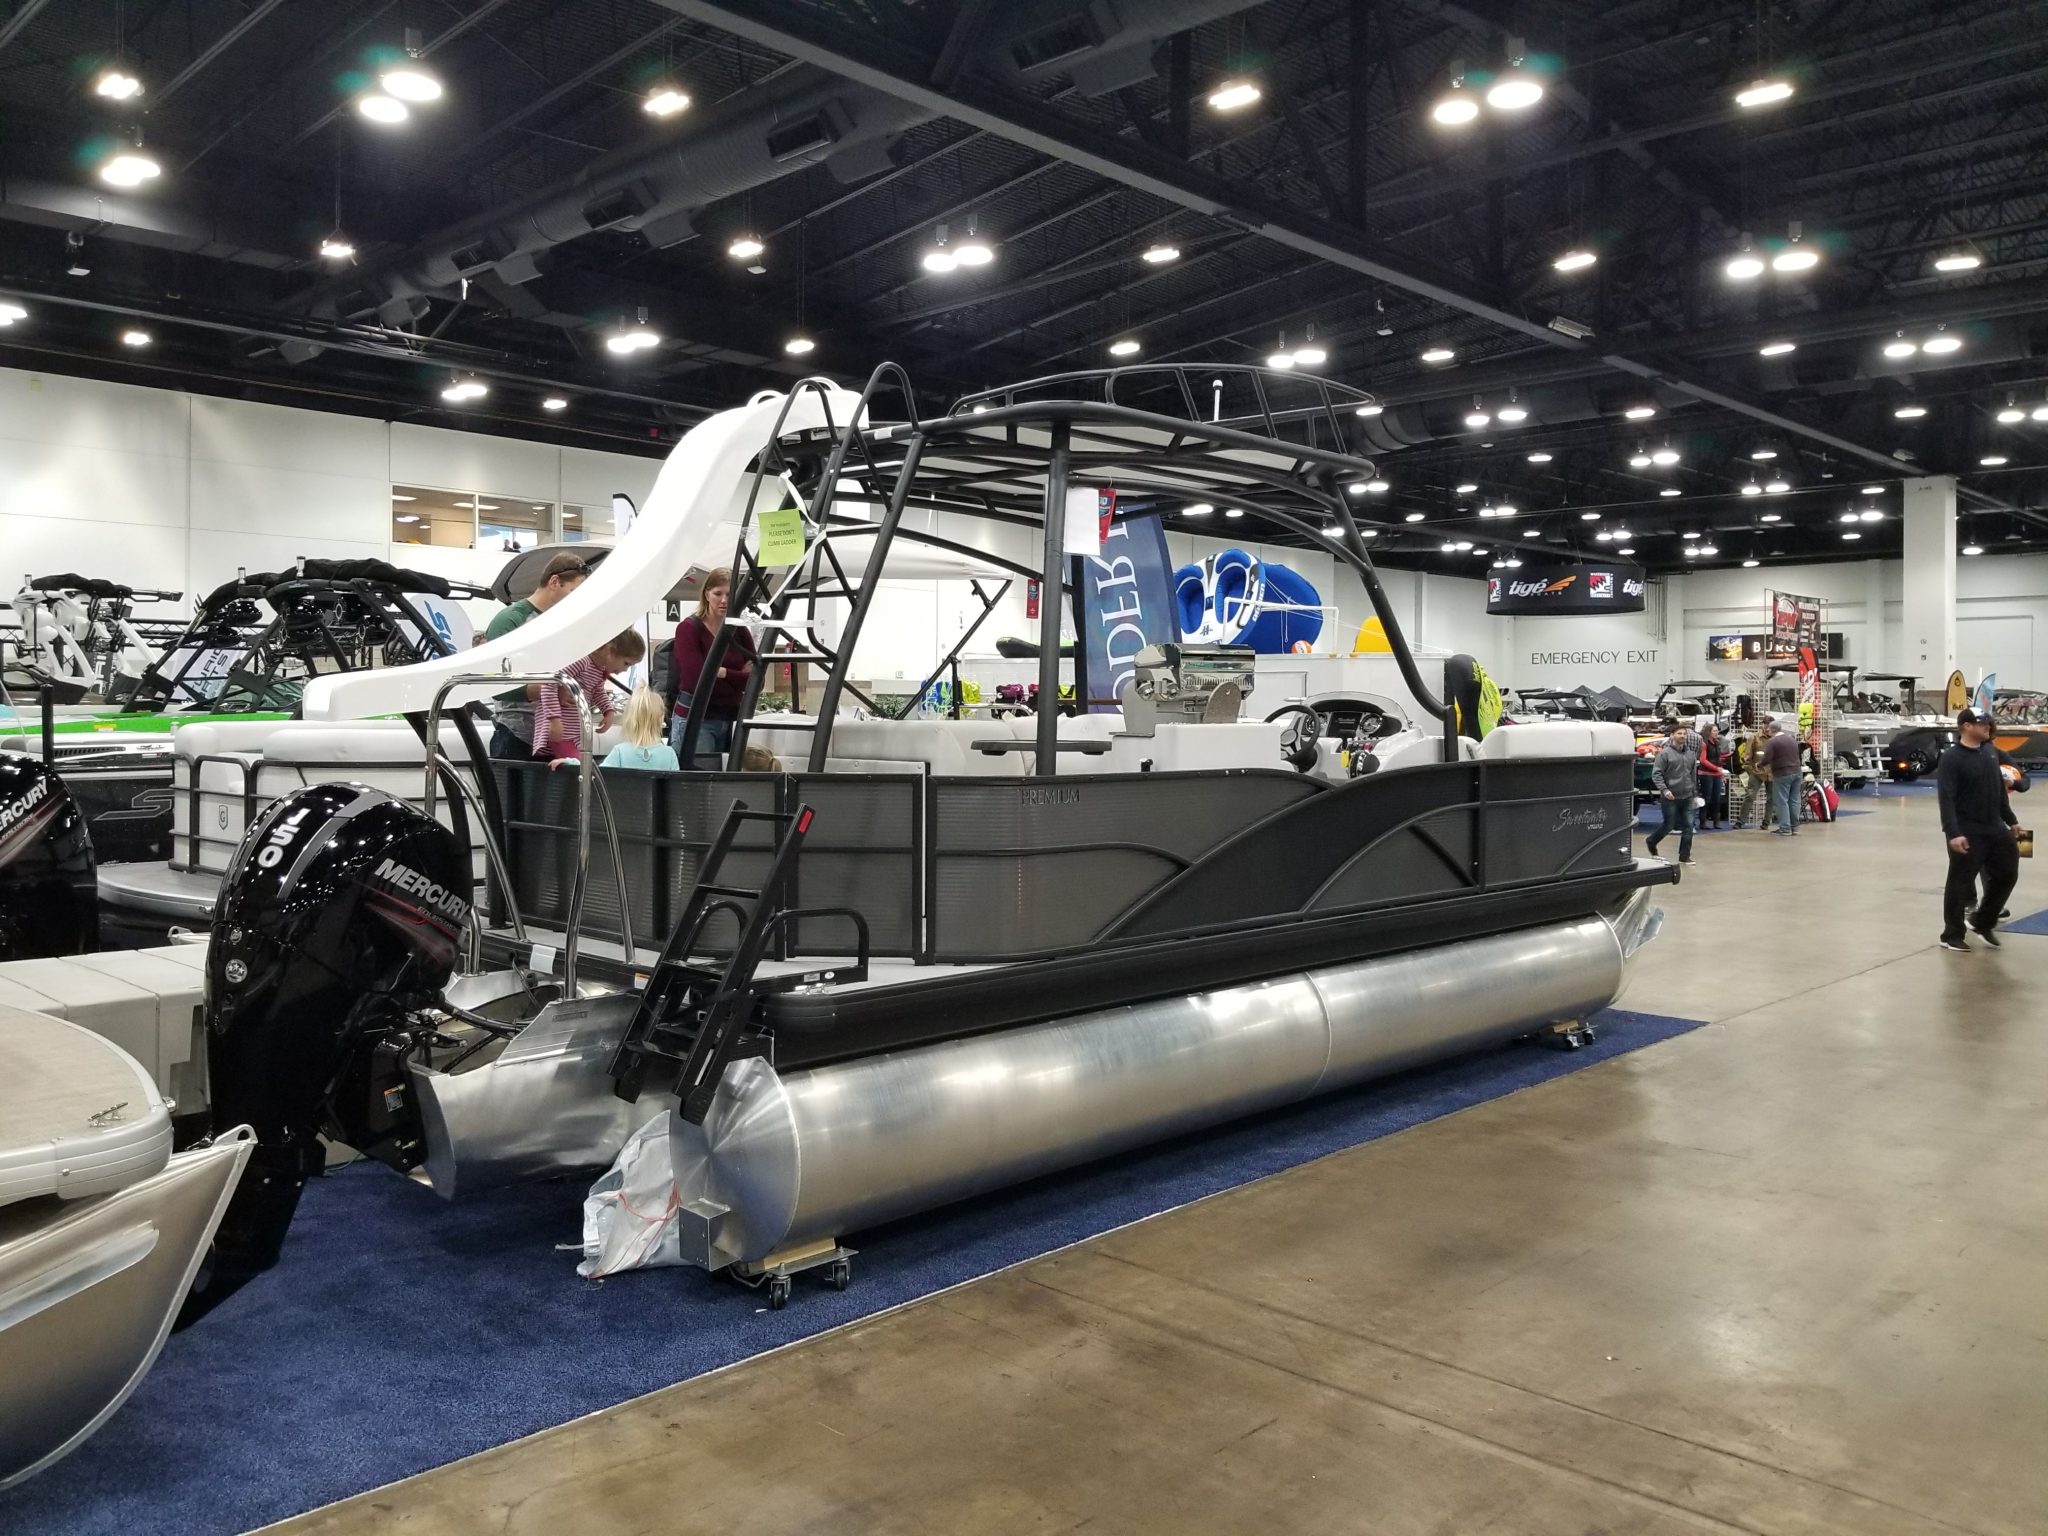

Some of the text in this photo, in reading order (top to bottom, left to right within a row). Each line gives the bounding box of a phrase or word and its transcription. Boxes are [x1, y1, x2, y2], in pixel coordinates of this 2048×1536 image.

[668, 603, 680, 617] A
[1531, 650, 1658, 665] EMERGENCY EXIT
[1021, 788, 1080, 805] PREMIUM
[257, 807, 311, 869] 150
[374, 857, 470, 920] MERCURY
